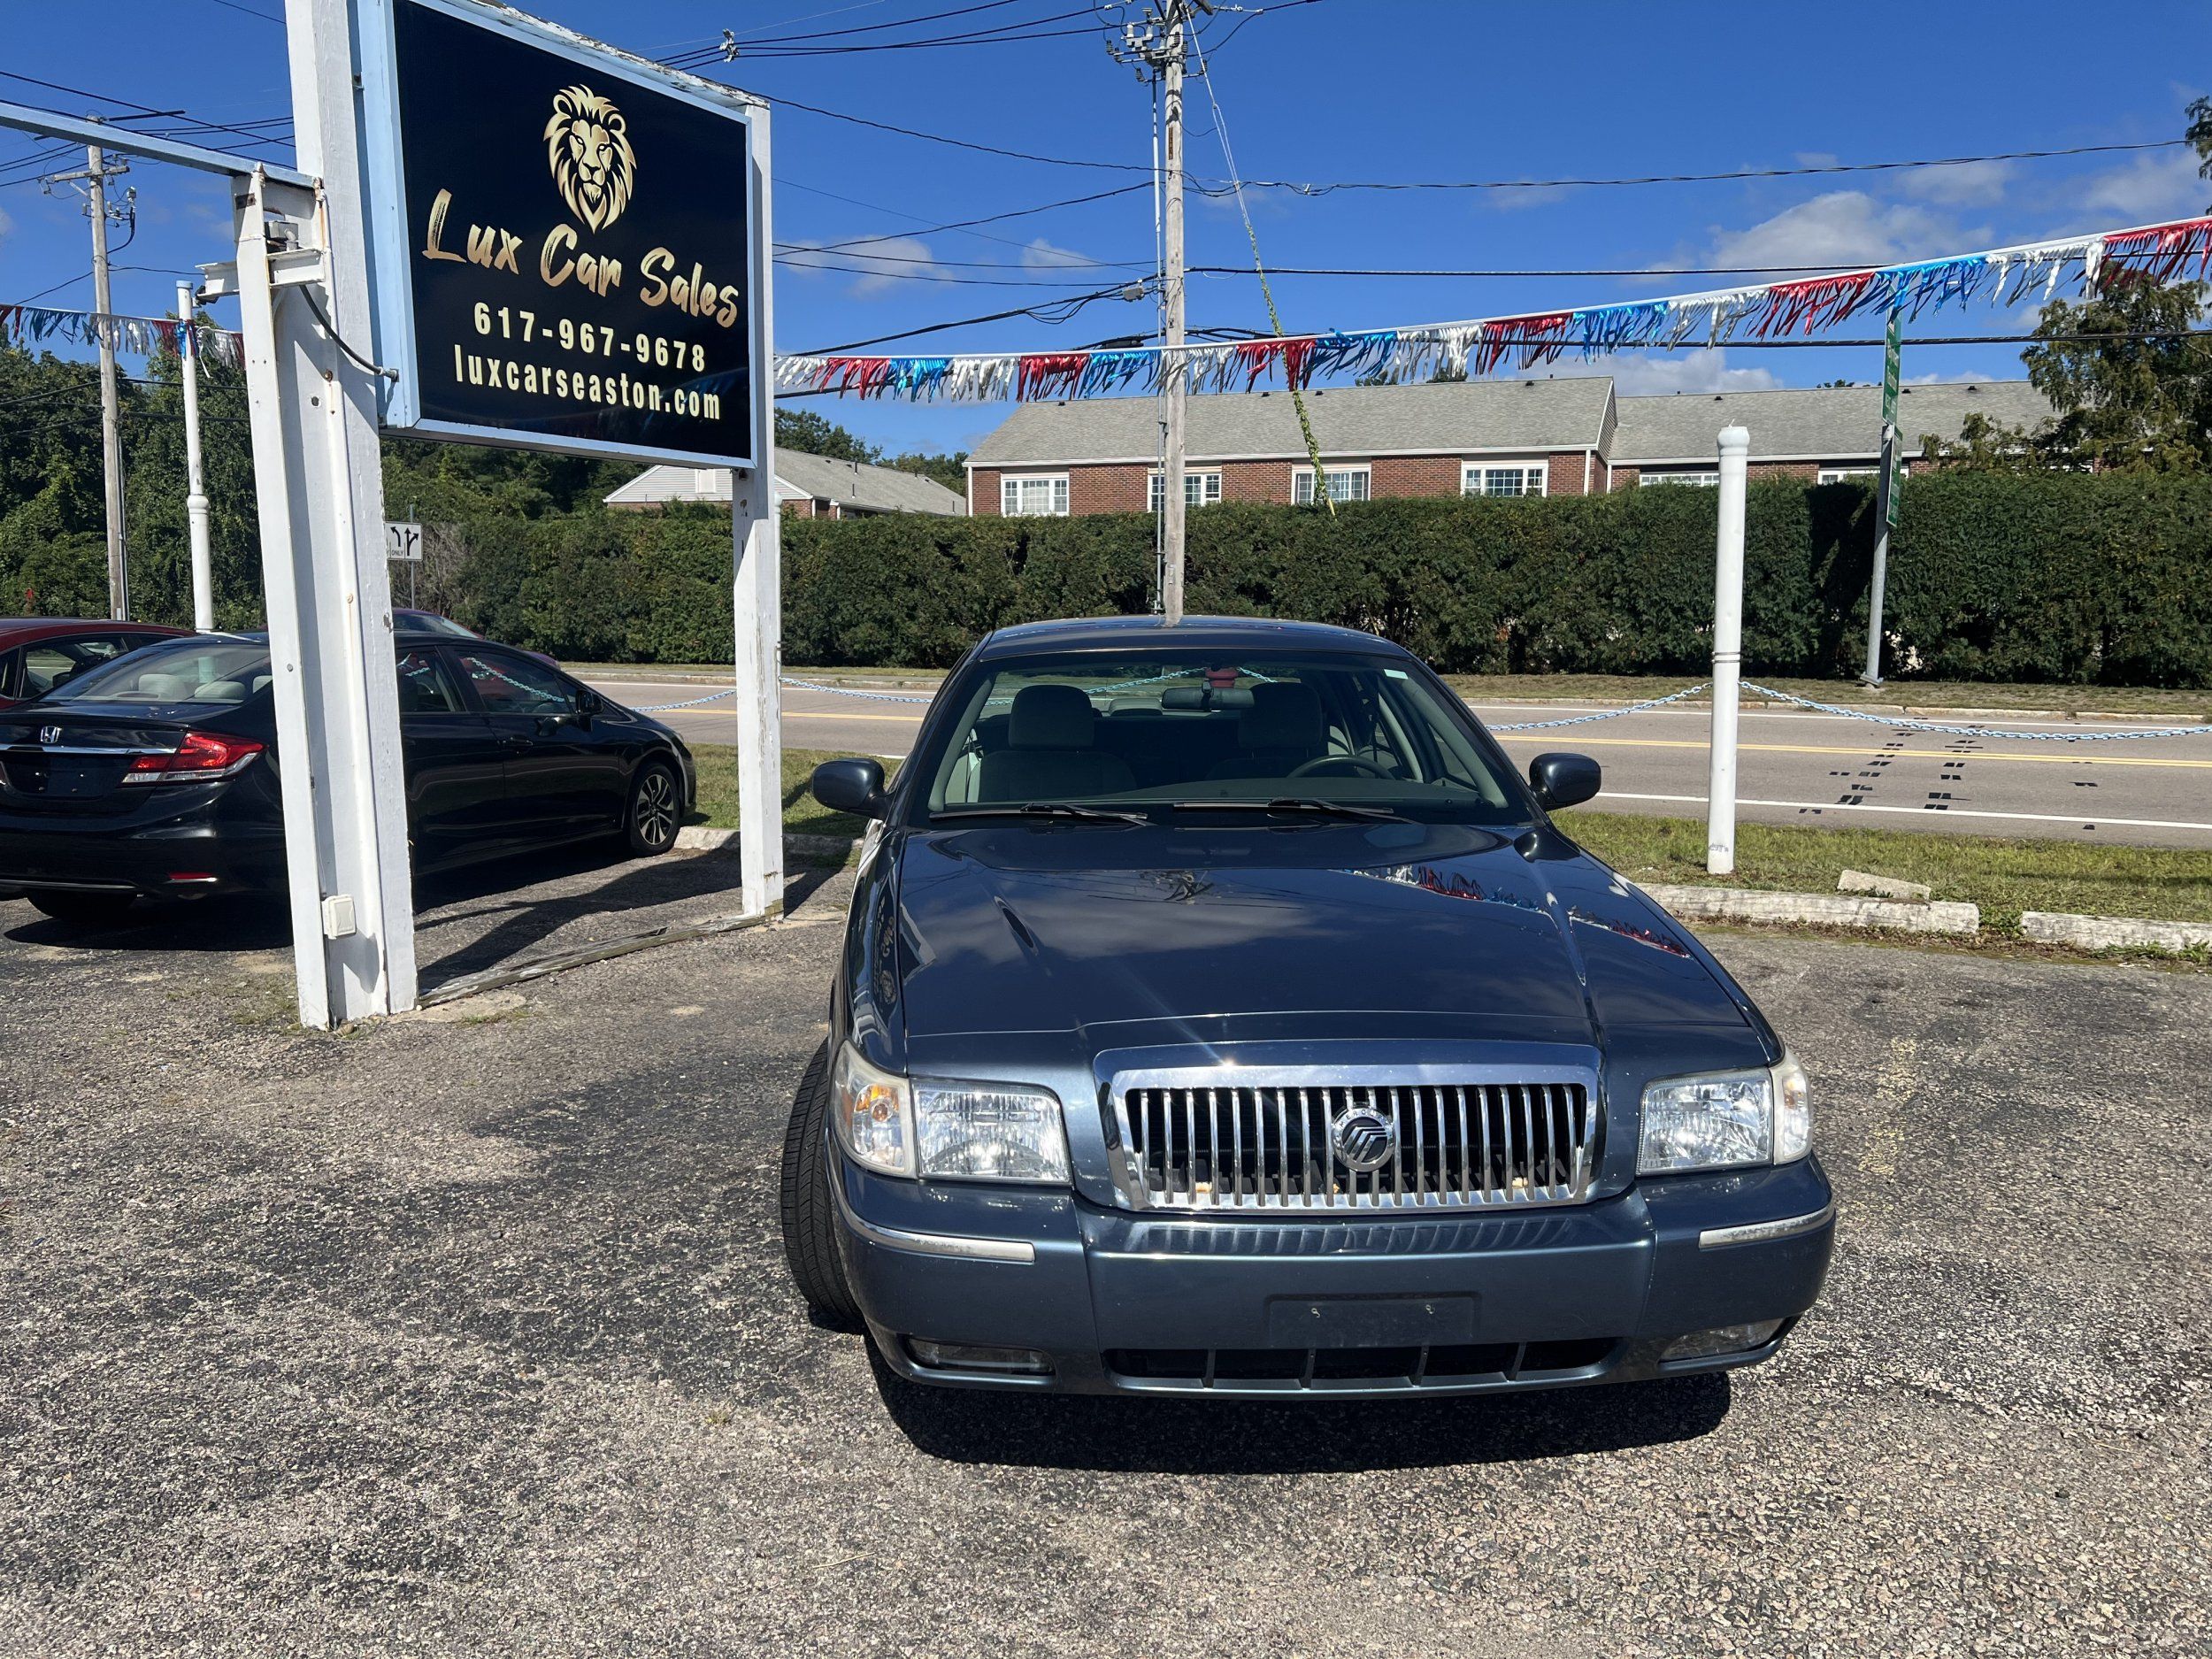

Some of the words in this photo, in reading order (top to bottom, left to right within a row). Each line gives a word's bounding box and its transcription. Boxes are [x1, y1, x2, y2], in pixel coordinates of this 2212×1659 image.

[422, 188, 523, 274] Lux
[541, 224, 622, 296] Car
[640, 247, 739, 328] Sales
[474, 303, 705, 372] 617-967-9678
[454, 344, 720, 419] luxcarseaston.com
